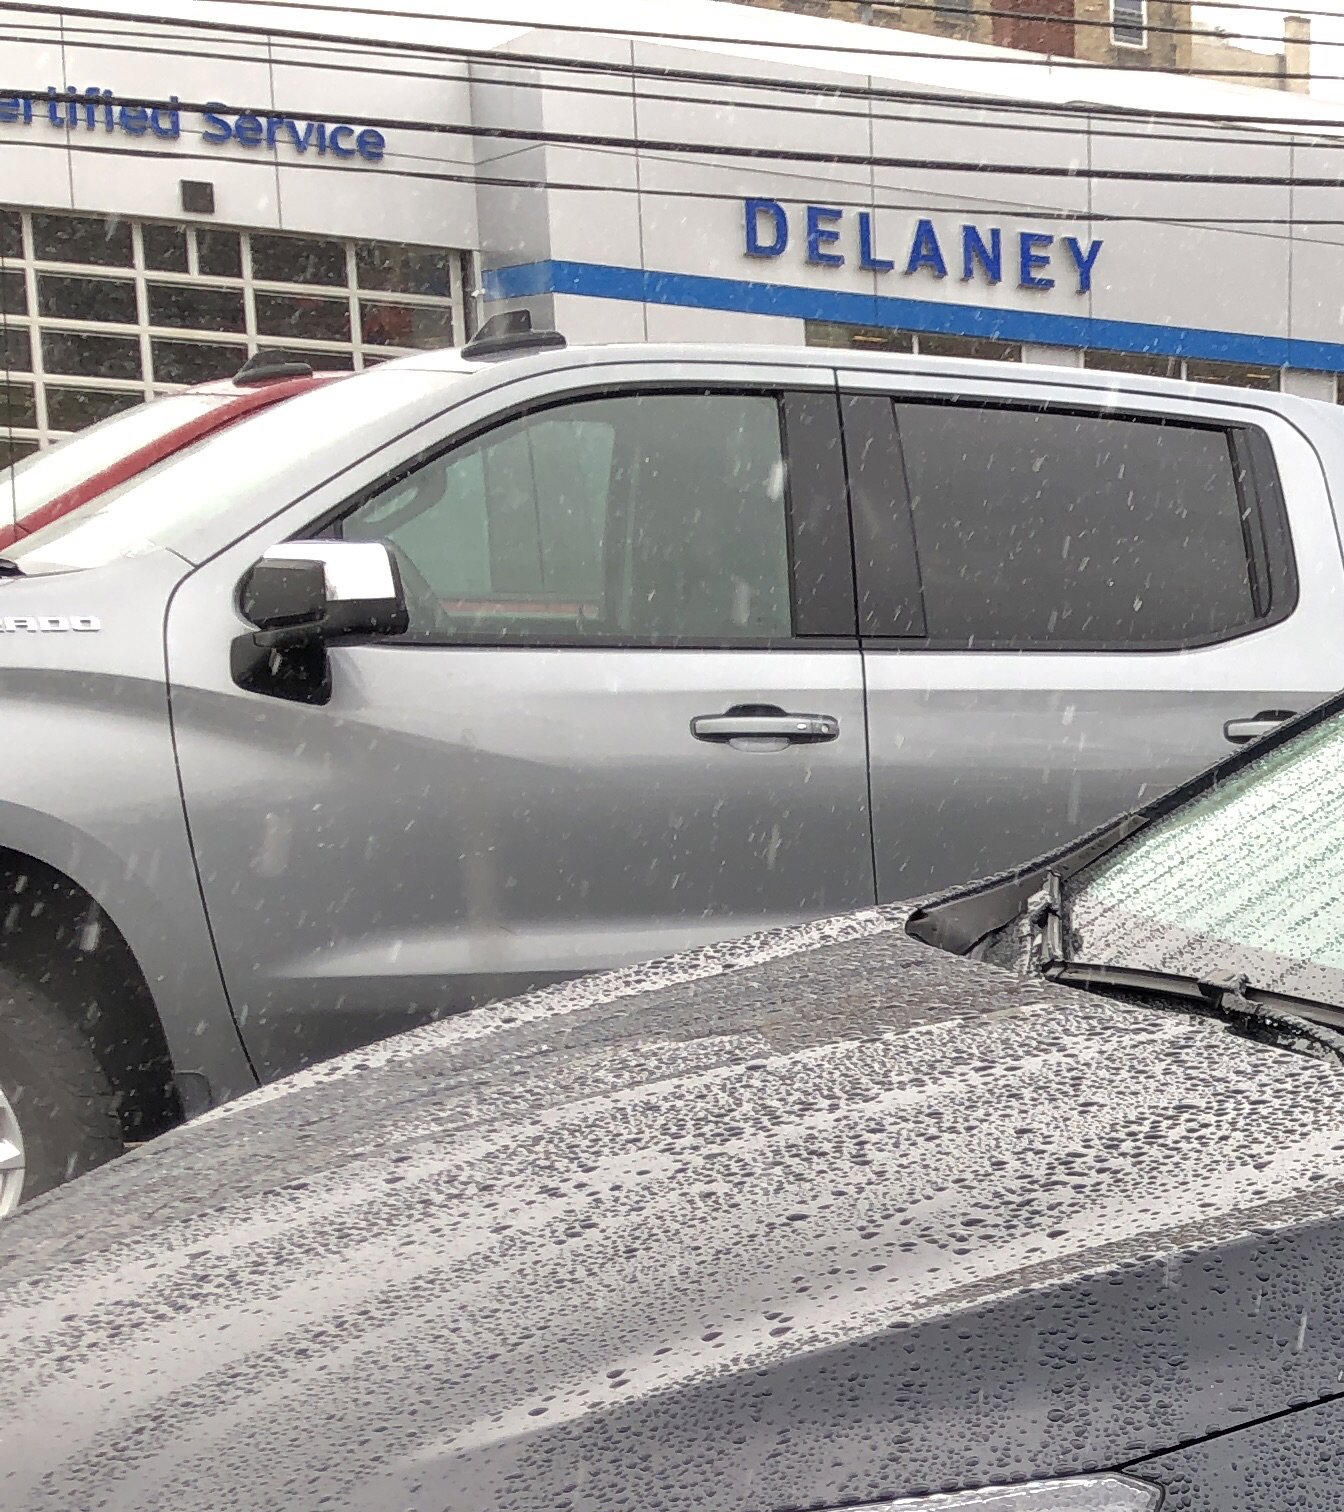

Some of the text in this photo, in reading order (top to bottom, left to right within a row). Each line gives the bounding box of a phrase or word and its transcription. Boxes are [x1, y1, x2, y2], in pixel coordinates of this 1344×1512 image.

[202, 101, 386, 161] Service
[742, 197, 1104, 295] DELANEY
[0, 616, 101, 633] ADO
